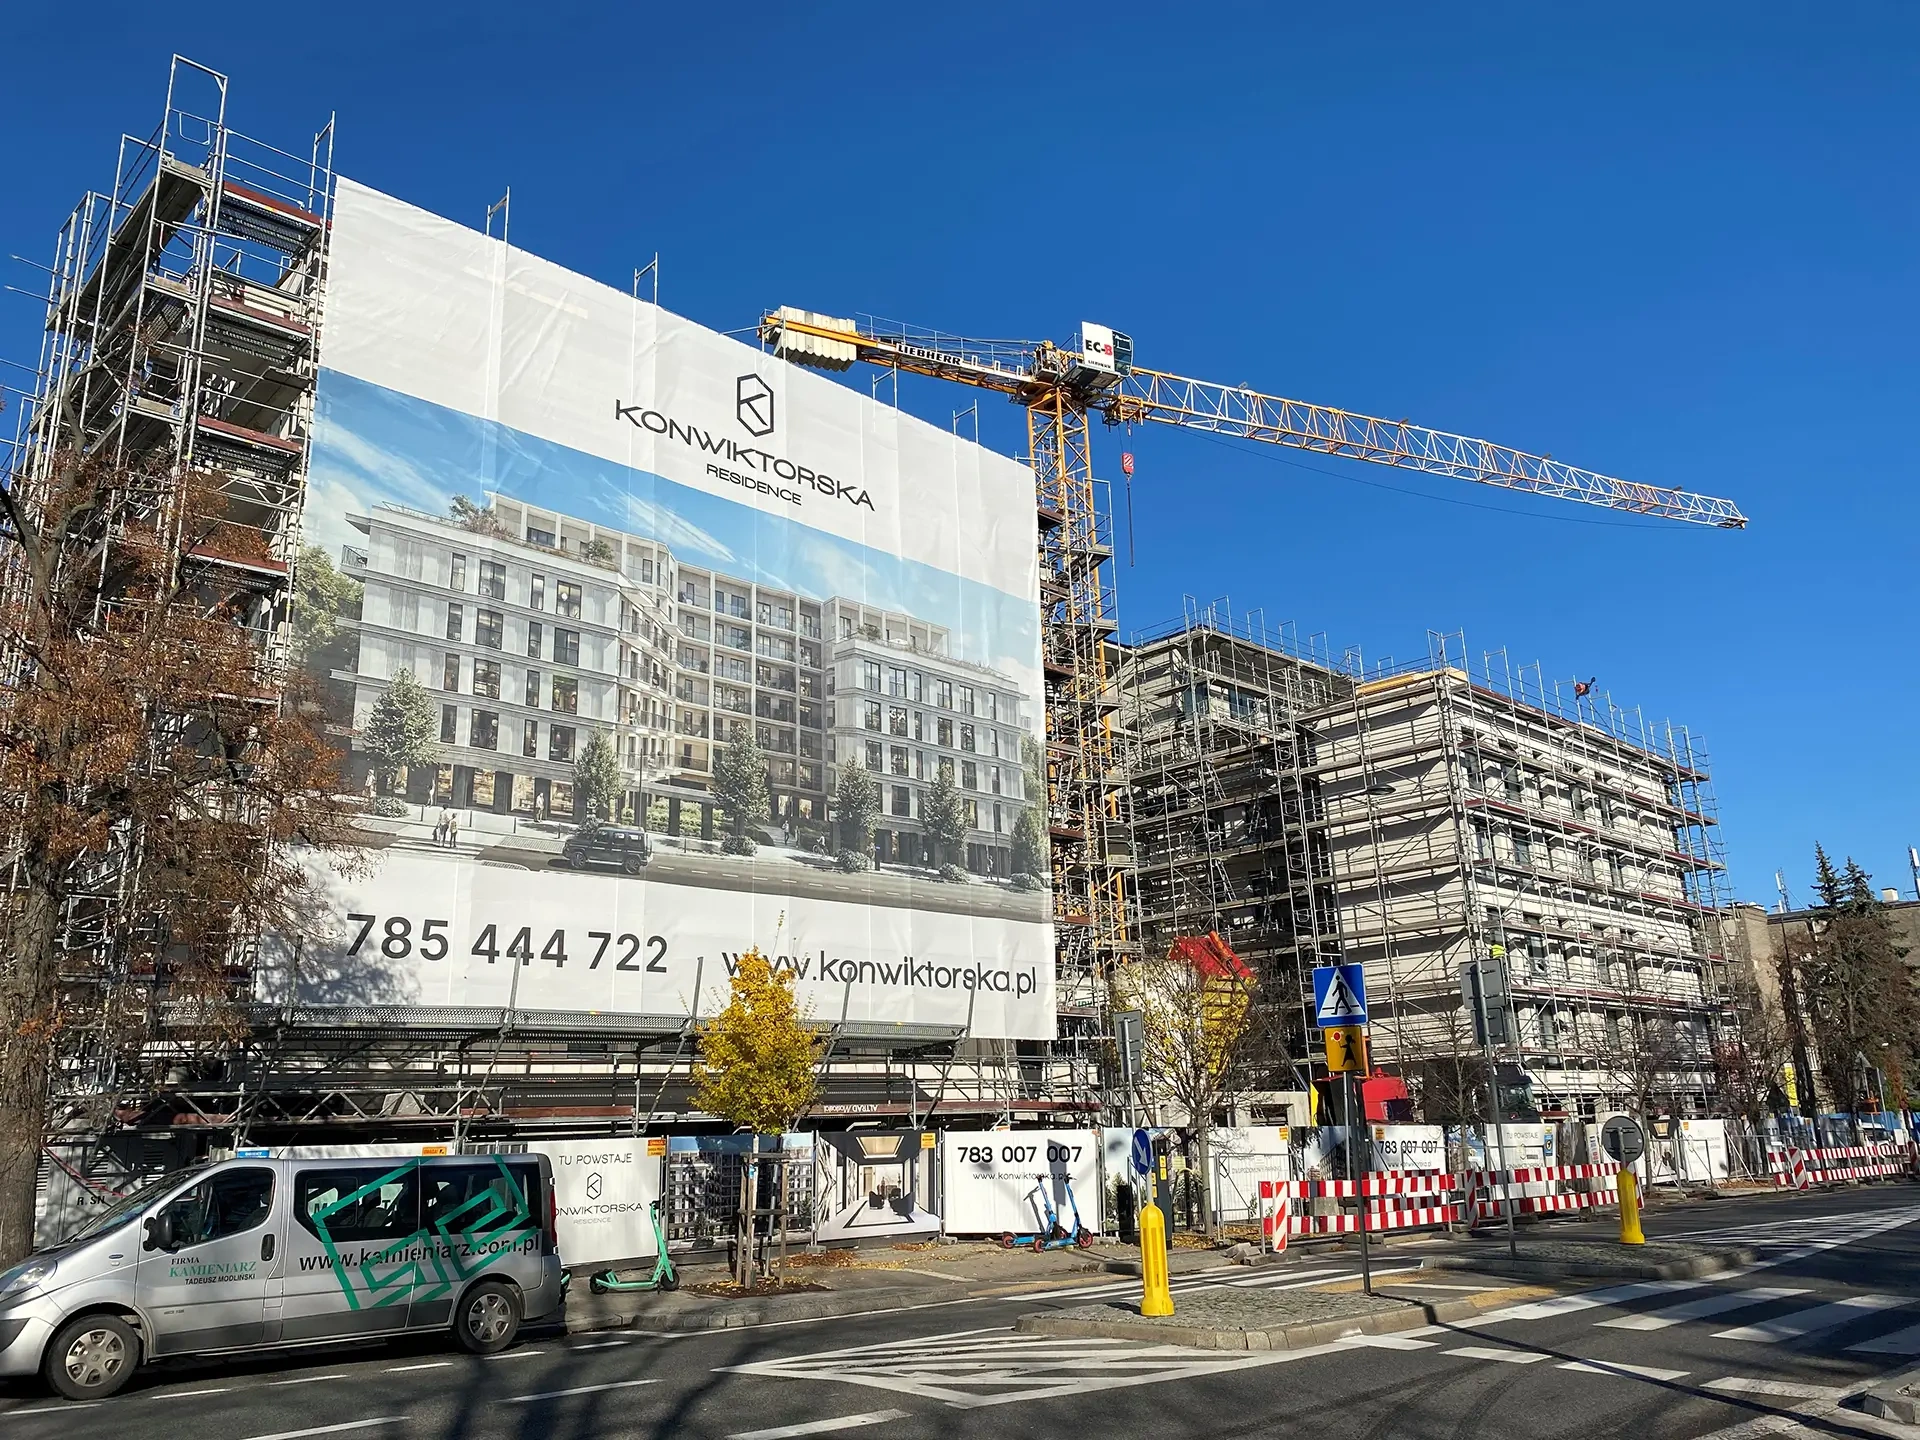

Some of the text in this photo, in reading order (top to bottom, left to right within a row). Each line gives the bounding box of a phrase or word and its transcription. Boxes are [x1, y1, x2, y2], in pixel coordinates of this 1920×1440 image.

[898, 344, 961, 366] LIEBHERR
[1085, 339, 1113, 356] EC-B
[615, 399, 875, 512] KONWIKTORSKA
[706, 463, 802, 506] RESIDENCE
[346, 913, 668, 973] 785 444 722
[957, 1146, 1082, 1163] 783 007 007
[1378, 1140, 1438, 1154] 783 007 007
[559, 1153, 632, 1166] TU POWSTAJE
[555, 1203, 643, 1216] NWIKTORSKA
[169, 1261, 257, 1278] KAMIENIARZ
[171, 1257, 200, 1265] FIRMA
[185, 1277, 217, 1285] TADEUSZ
